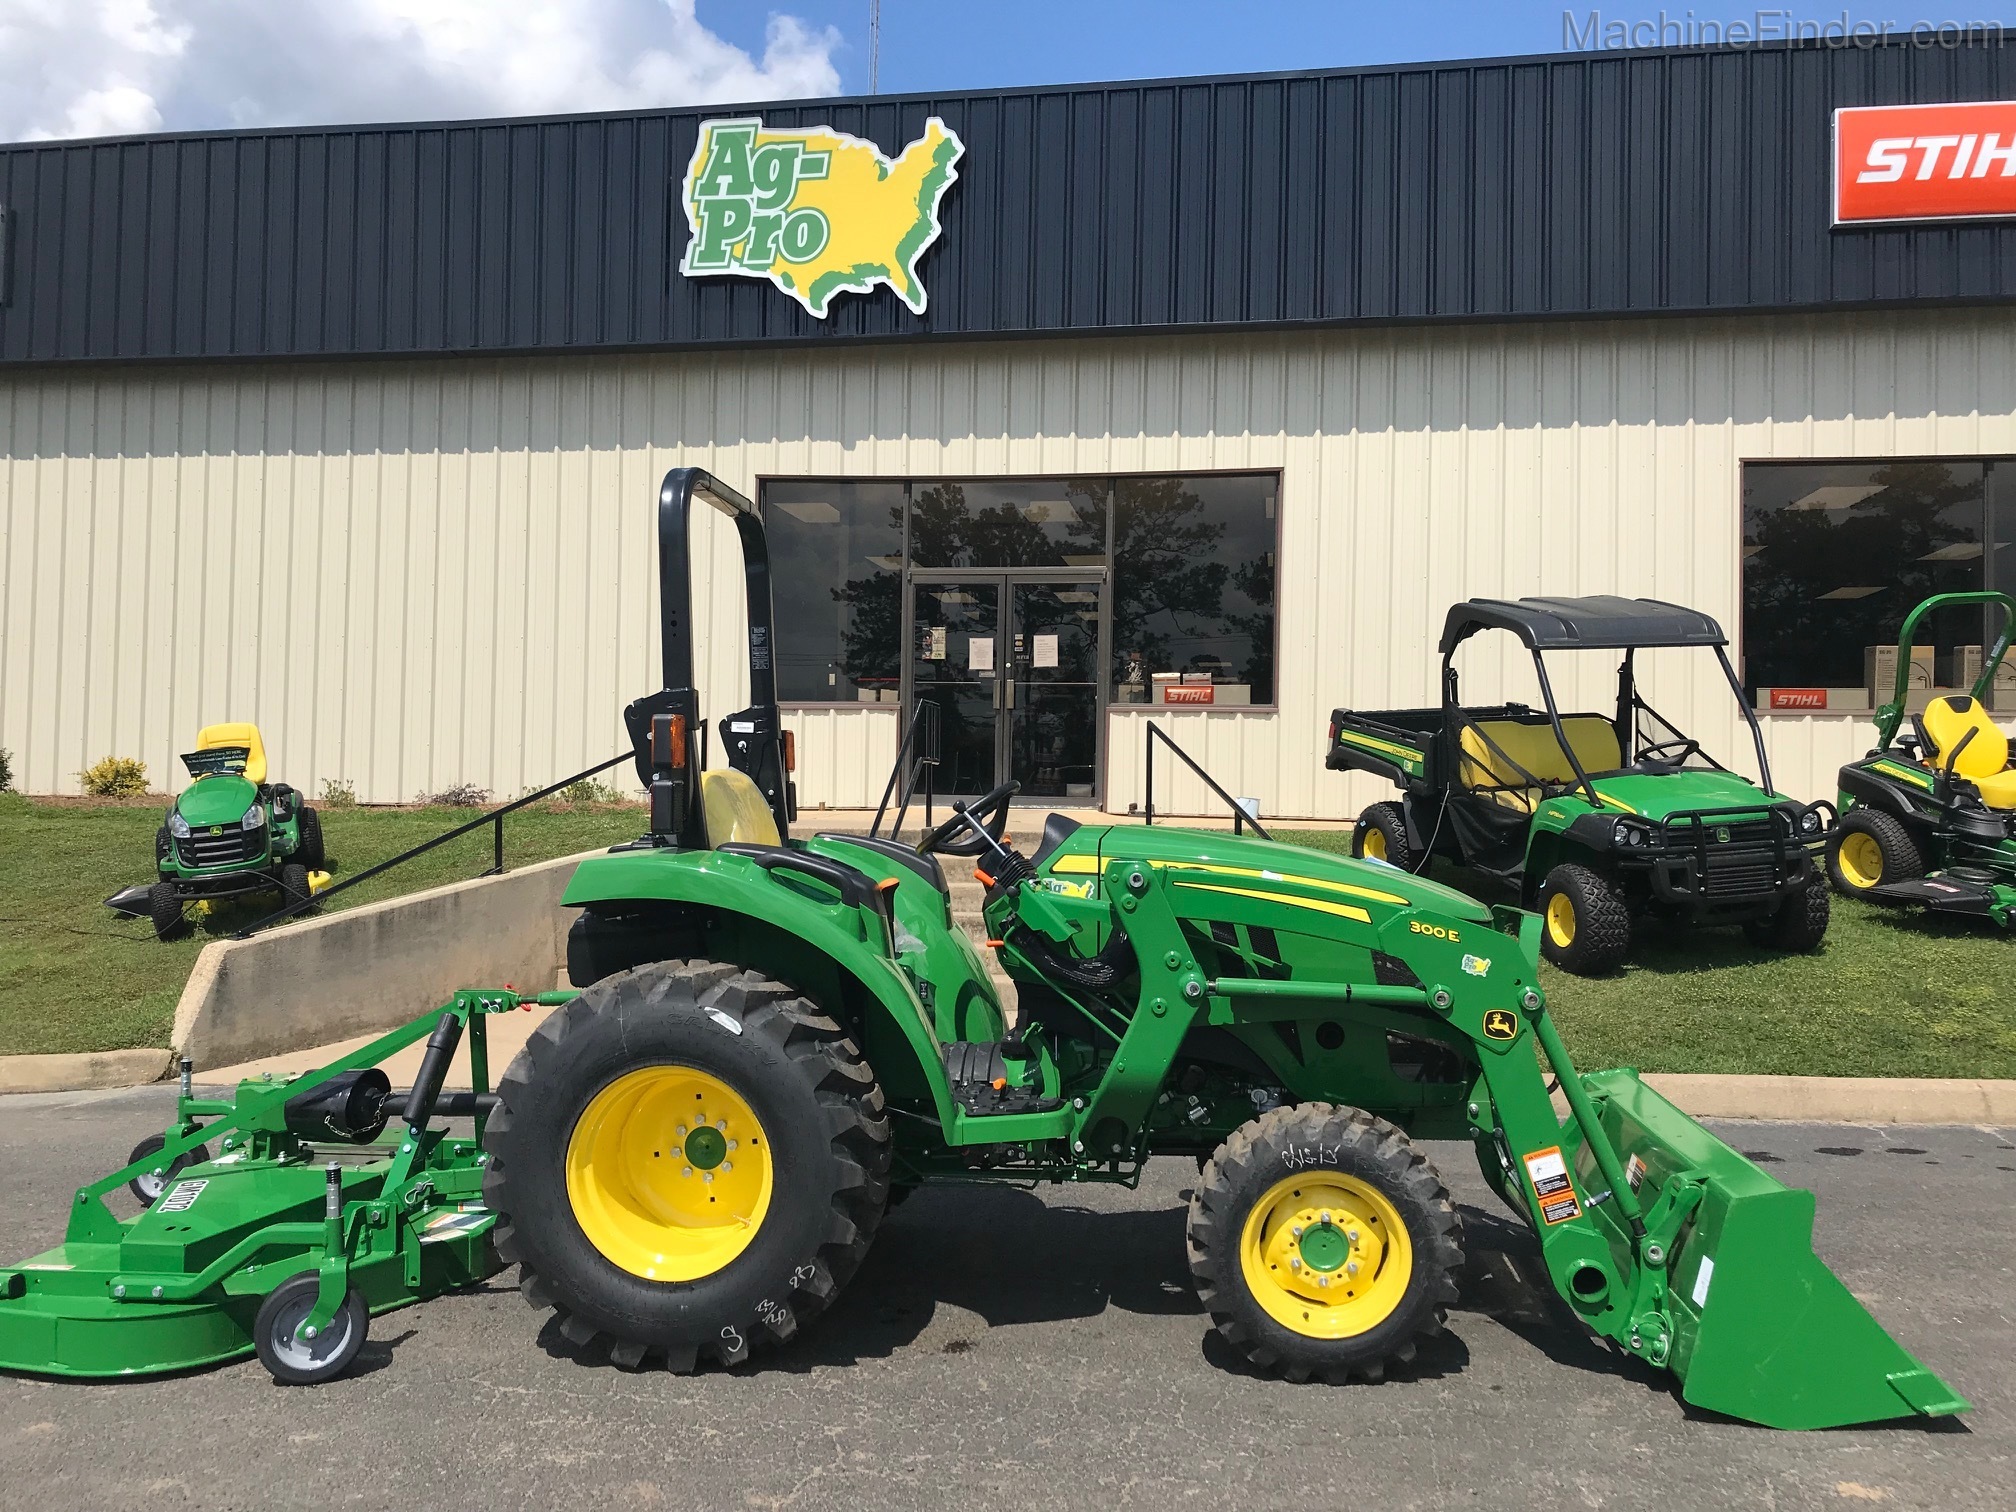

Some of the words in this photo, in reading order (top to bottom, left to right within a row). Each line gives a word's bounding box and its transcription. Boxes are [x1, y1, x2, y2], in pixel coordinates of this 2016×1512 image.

[693, 124, 832, 213] Ag-
[689, 198, 831, 269] Pro
[1168, 690, 1208, 702] STIHL
[1775, 695, 1823, 706] STIHL
